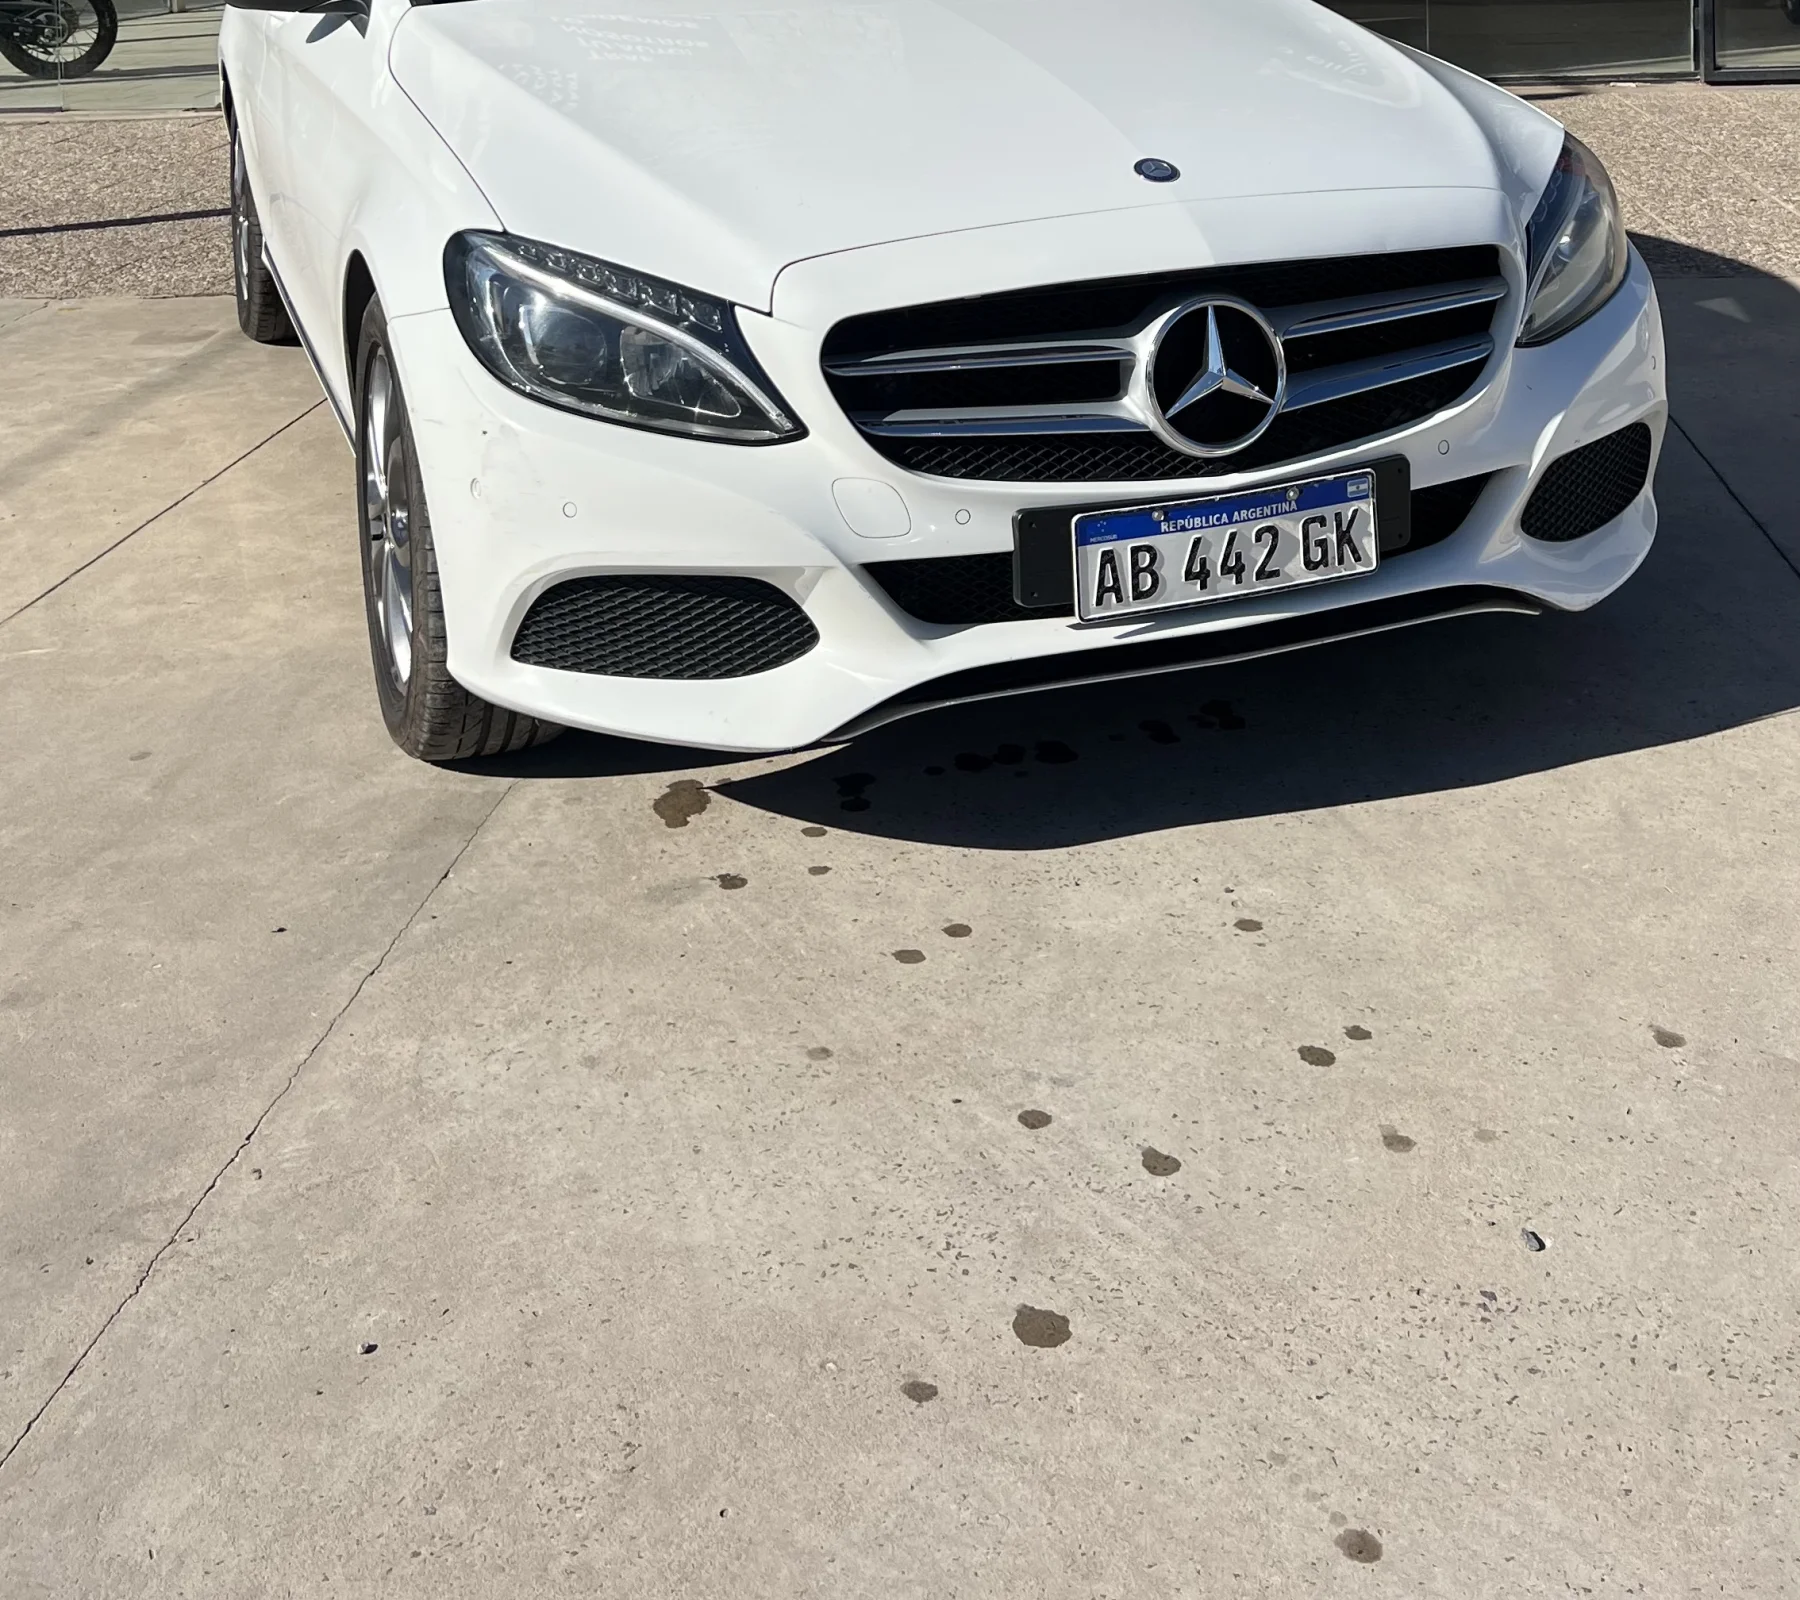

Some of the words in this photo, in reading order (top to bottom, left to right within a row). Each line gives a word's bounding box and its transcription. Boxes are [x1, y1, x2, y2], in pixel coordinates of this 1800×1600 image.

[1161, 512, 1229, 533] REPÚBLICA
[1233, 500, 1297, 524] ARGENTINA
[1095, 543, 1160, 607] AB
[1182, 525, 1281, 591] 442
[1300, 507, 1363, 571] GK
